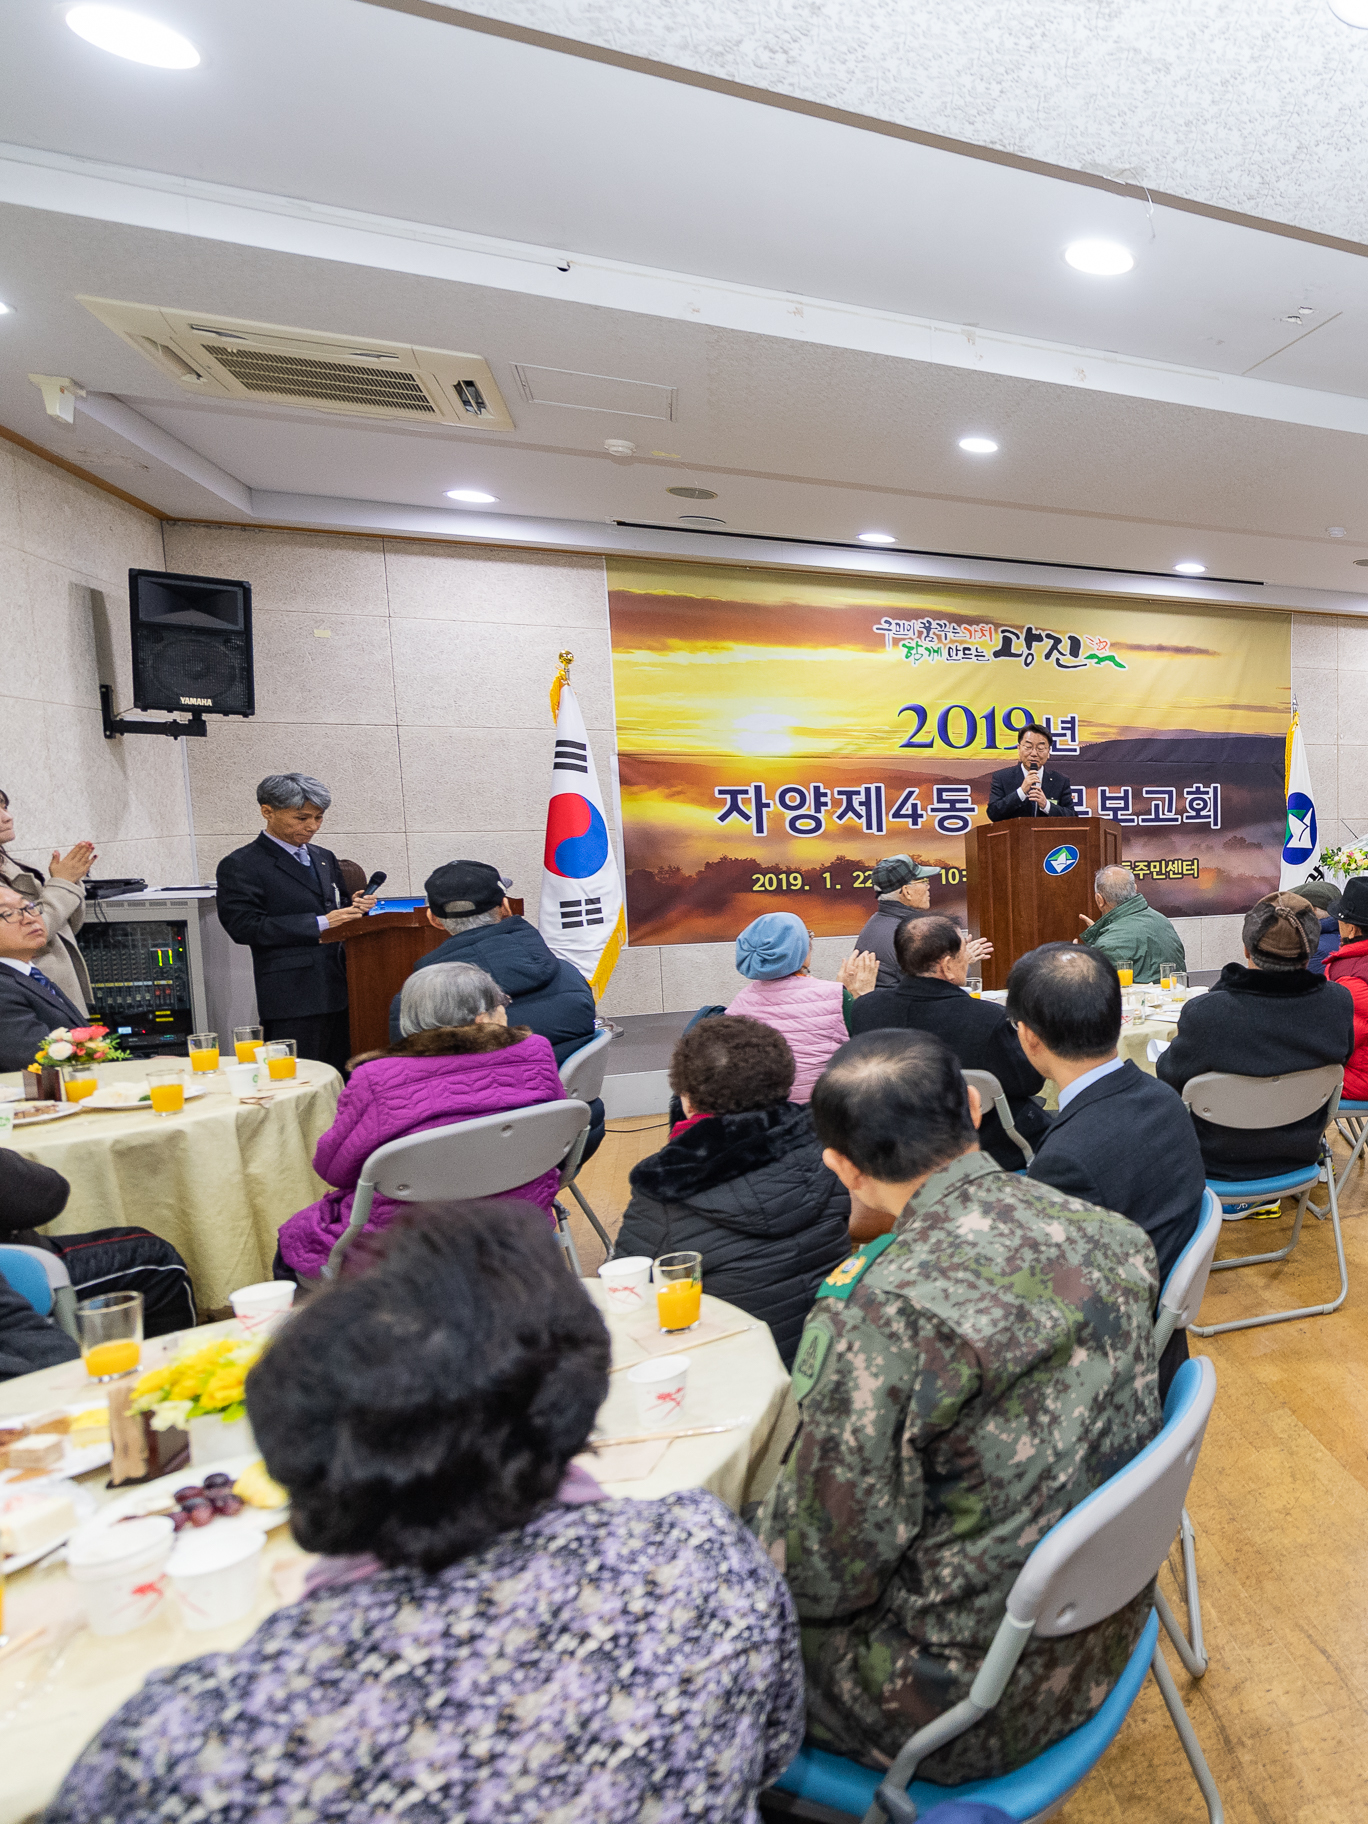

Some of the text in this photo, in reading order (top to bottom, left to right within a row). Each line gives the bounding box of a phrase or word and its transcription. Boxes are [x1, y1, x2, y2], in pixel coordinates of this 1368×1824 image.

[901, 625, 1088, 669] 함께 만드는 광진
[180, 696, 213, 707] YAMAHA
[714, 782, 1221, 837] 자양제4동 보고회
[751, 872, 810, 891] 2019.
[822, 872, 841, 889] 1.
